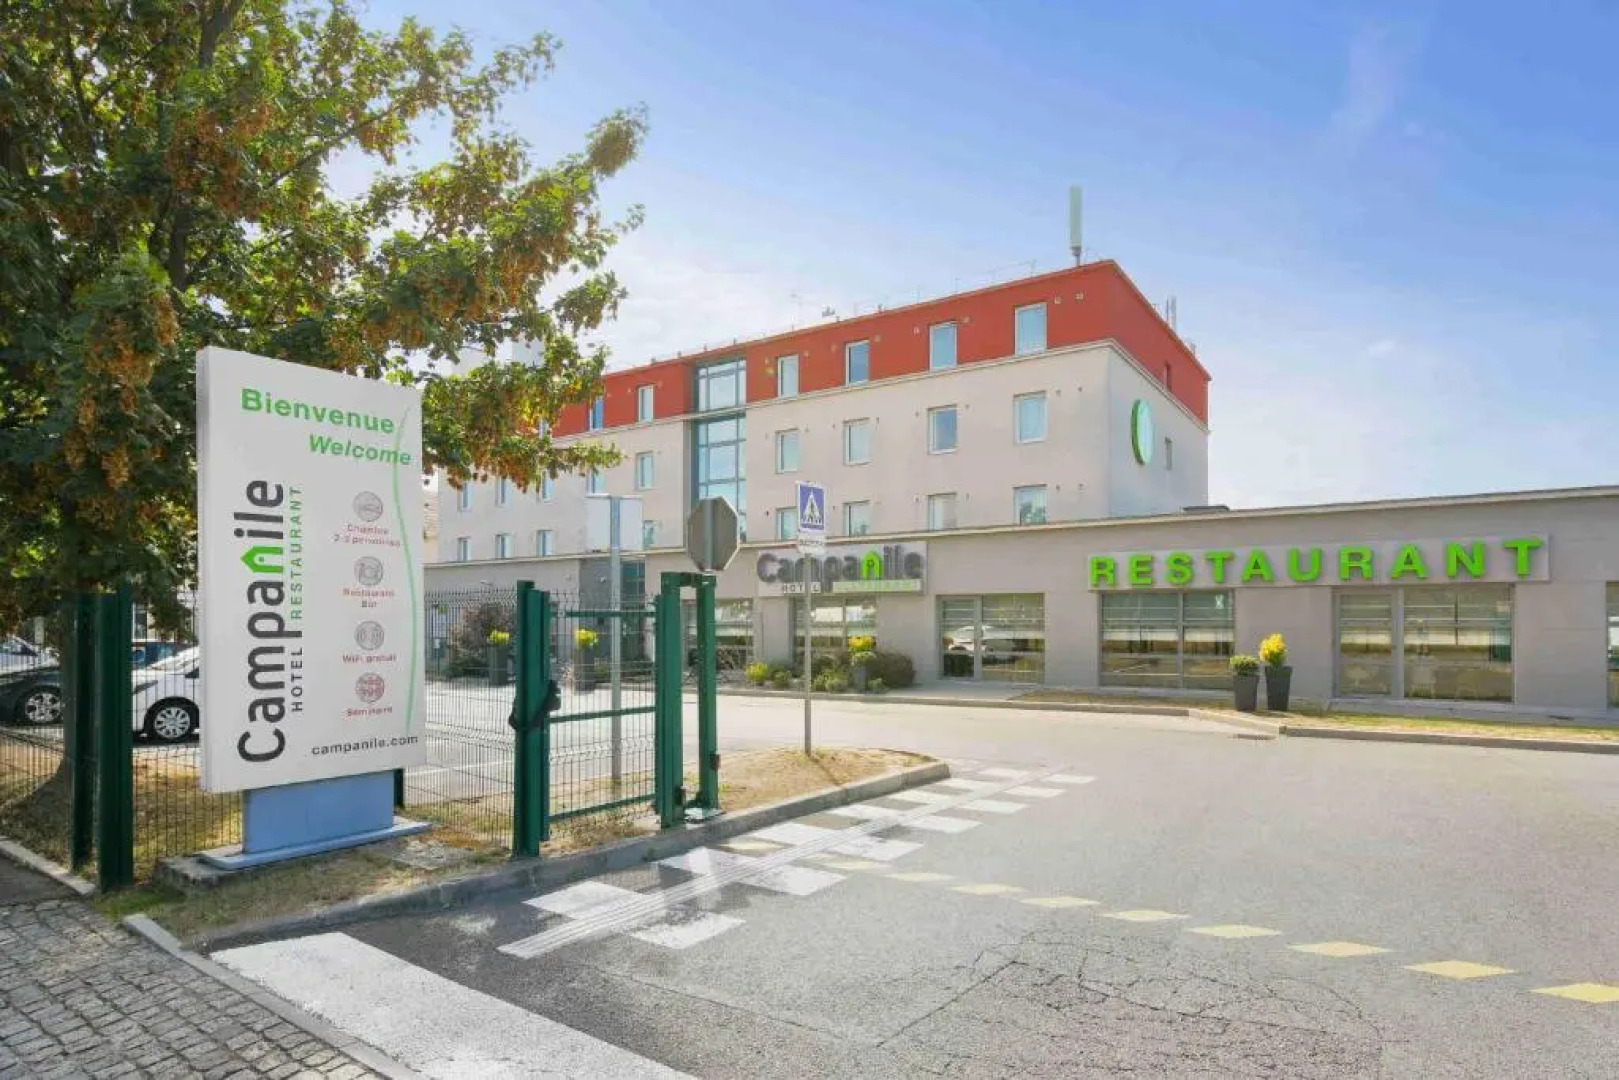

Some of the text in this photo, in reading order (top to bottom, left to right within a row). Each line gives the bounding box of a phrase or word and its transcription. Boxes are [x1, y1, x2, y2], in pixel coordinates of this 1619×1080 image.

[241, 387, 394, 434] Bienvenue
[309, 433, 411, 465] Welcome
[757, 545, 924, 594] Campanile
[1088, 535, 1544, 588] RESTAURANT
[289, 486, 303, 712] HOTEL RESTAURANT
[781, 582, 820, 594] HOTL
[233, 479, 303, 762] Campanile
[311, 734, 419, 756] campanile.com
